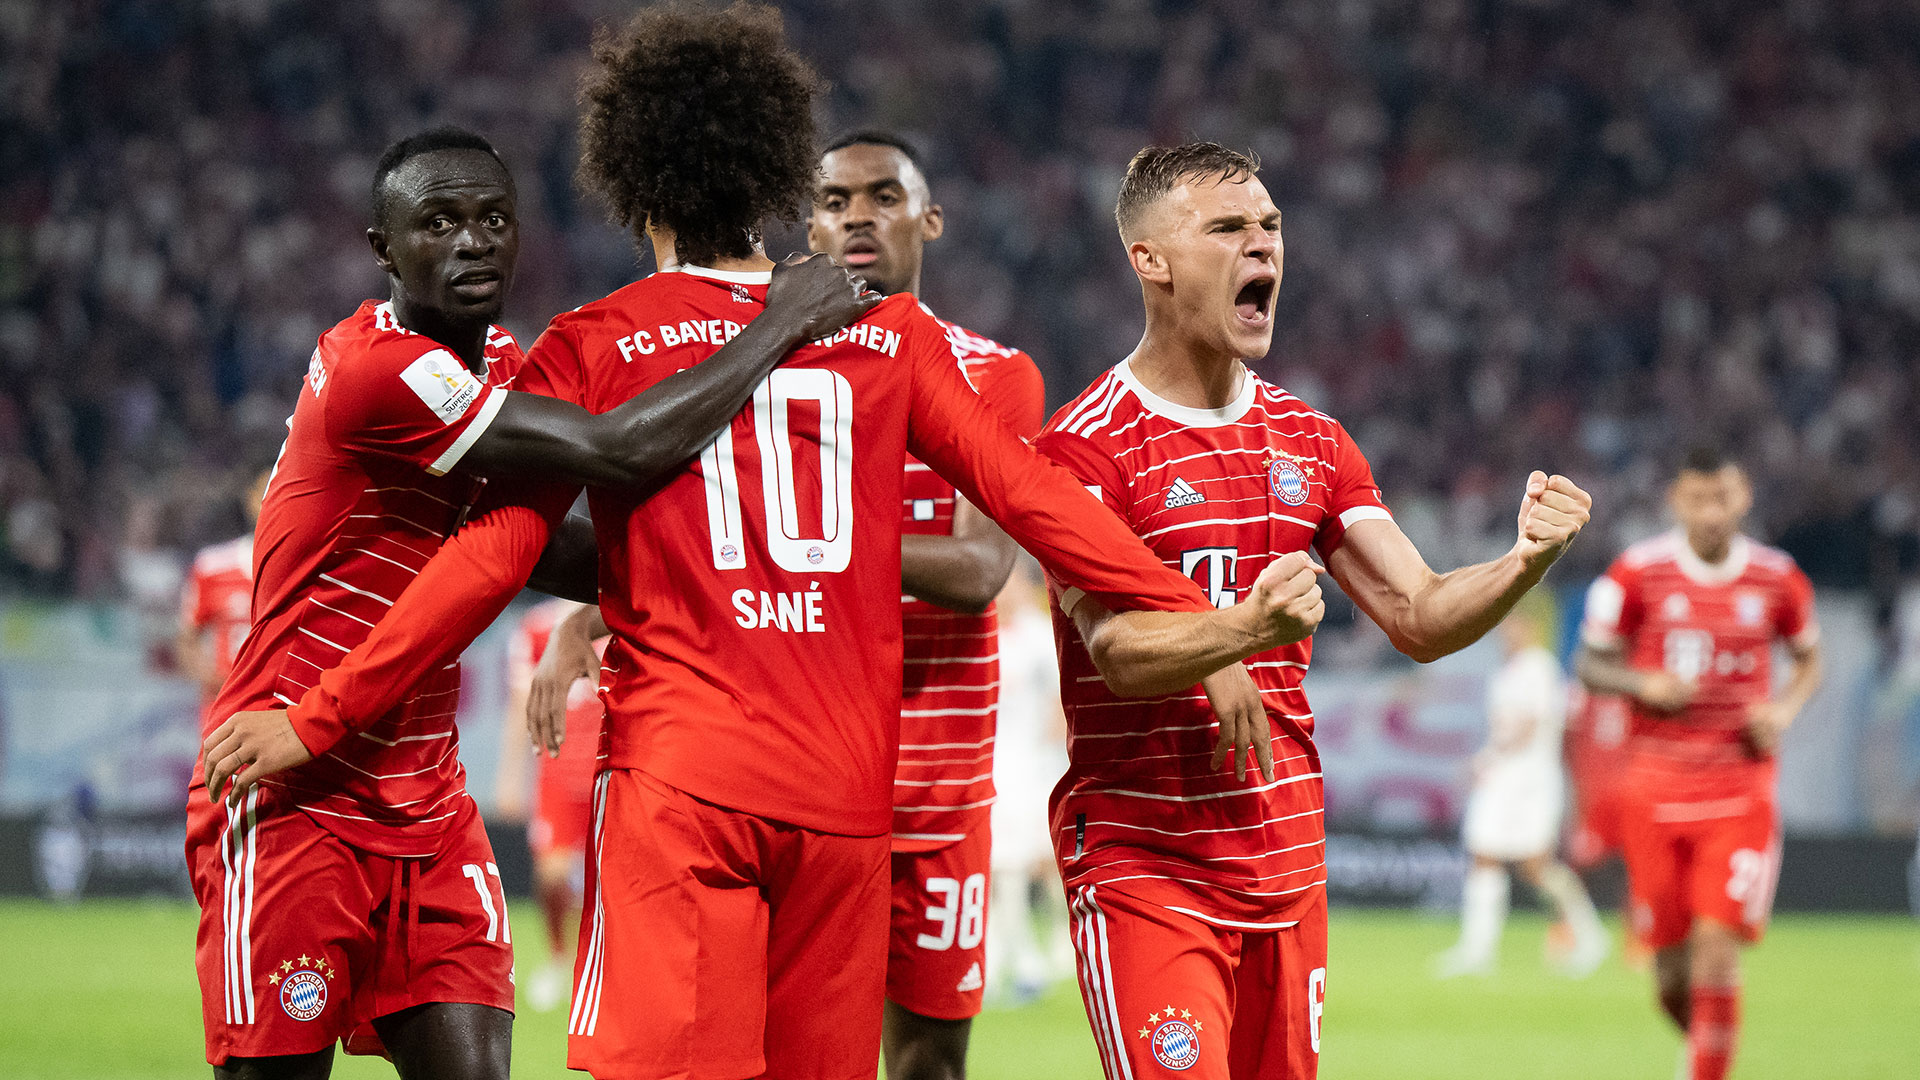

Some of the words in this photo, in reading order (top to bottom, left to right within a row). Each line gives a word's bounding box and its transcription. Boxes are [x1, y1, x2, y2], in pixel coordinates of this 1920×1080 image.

[616, 330, 656, 363] FC
[659, 319, 748, 347] BAYER
[814, 324, 902, 358] CHEN
[445, 384, 474, 414] SUPERCUP
[677, 368, 853, 573] 10
[1273, 465, 1281, 477] FC
[1279, 462, 1306, 482] BAYERN
[1165, 492, 1205, 508] adidas
[731, 581, 826, 633] SANÉ
[462, 862, 511, 944] 17
[917, 873, 985, 951] 38
[284, 982, 295, 994] FC
[293, 974, 324, 992] BAYERN
[1308, 967, 1326, 1053] 6
[1155, 1032, 1165, 1045] FC
[1162, 1023, 1195, 1041] BAYERN
